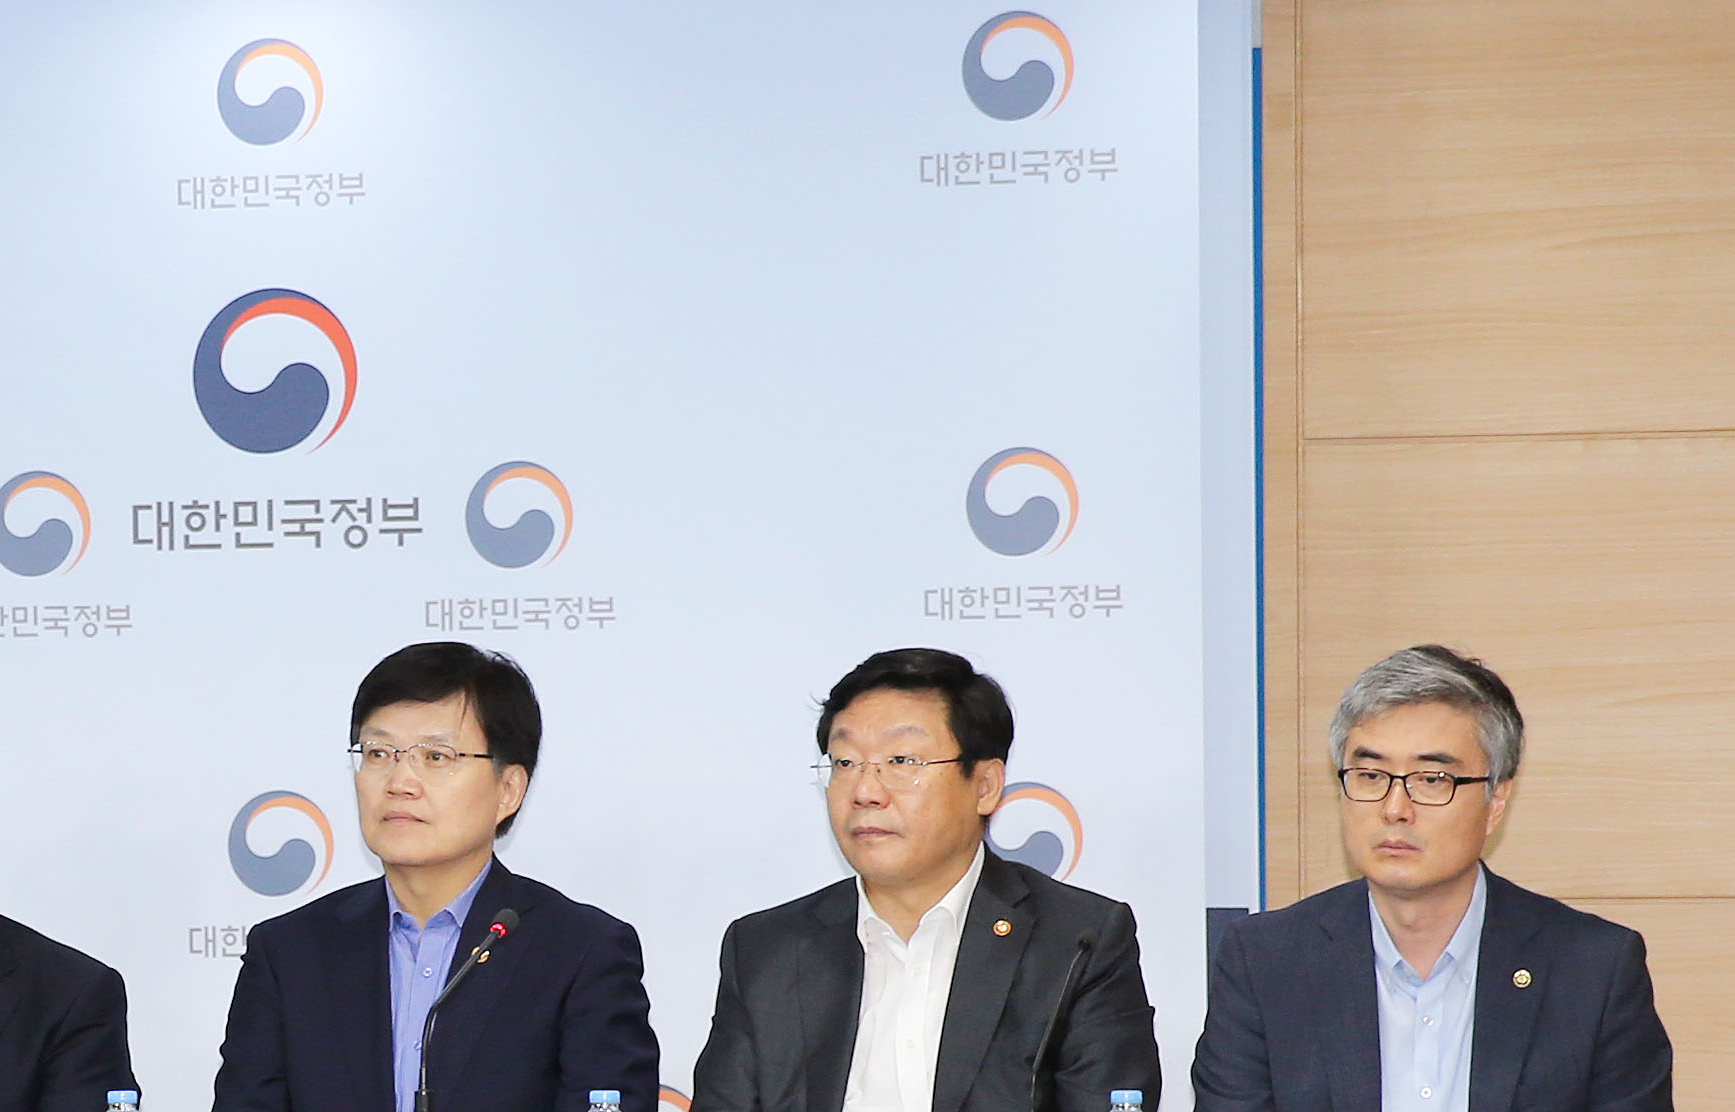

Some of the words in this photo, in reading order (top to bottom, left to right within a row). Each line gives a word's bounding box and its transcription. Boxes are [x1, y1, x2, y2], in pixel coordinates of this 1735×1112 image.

[920, 148, 1118, 187] 대한민국정부
[177, 173, 366, 209] 대한민국정부
[131, 496, 424, 552] 대한민국정부
[425, 596, 616, 632] 대한민국정부
[924, 584, 1123, 621] 대한민국정부
